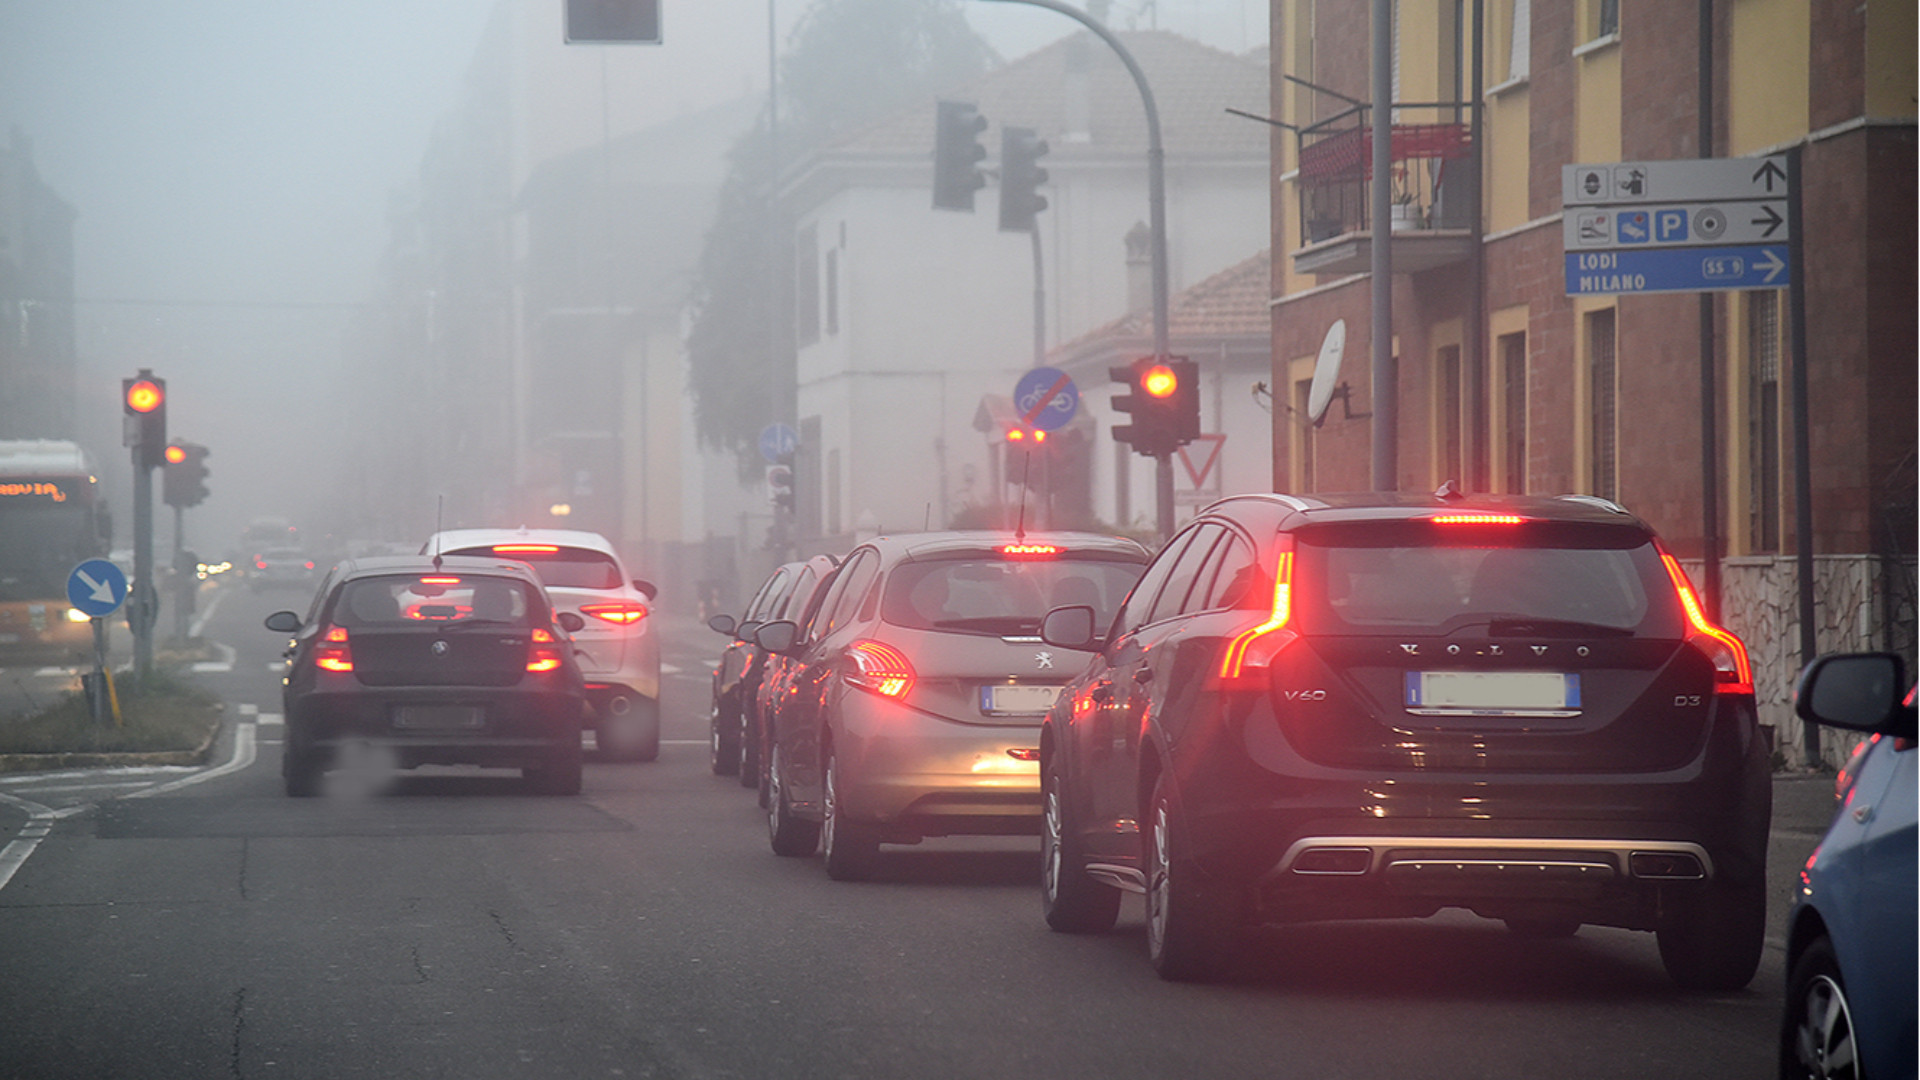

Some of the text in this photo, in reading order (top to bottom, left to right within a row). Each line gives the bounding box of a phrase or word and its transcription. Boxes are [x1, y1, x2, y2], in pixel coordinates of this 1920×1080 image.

[1662, 213, 1681, 239] P
[1579, 253, 1618, 270] LODI
[1707, 260, 1741, 274] SS 9
[1580, 274, 1646, 292] MILANO
[1400, 644, 1590, 657] VOLVO
[1284, 690, 1327, 701] V60
[1674, 695, 1701, 707] D3
